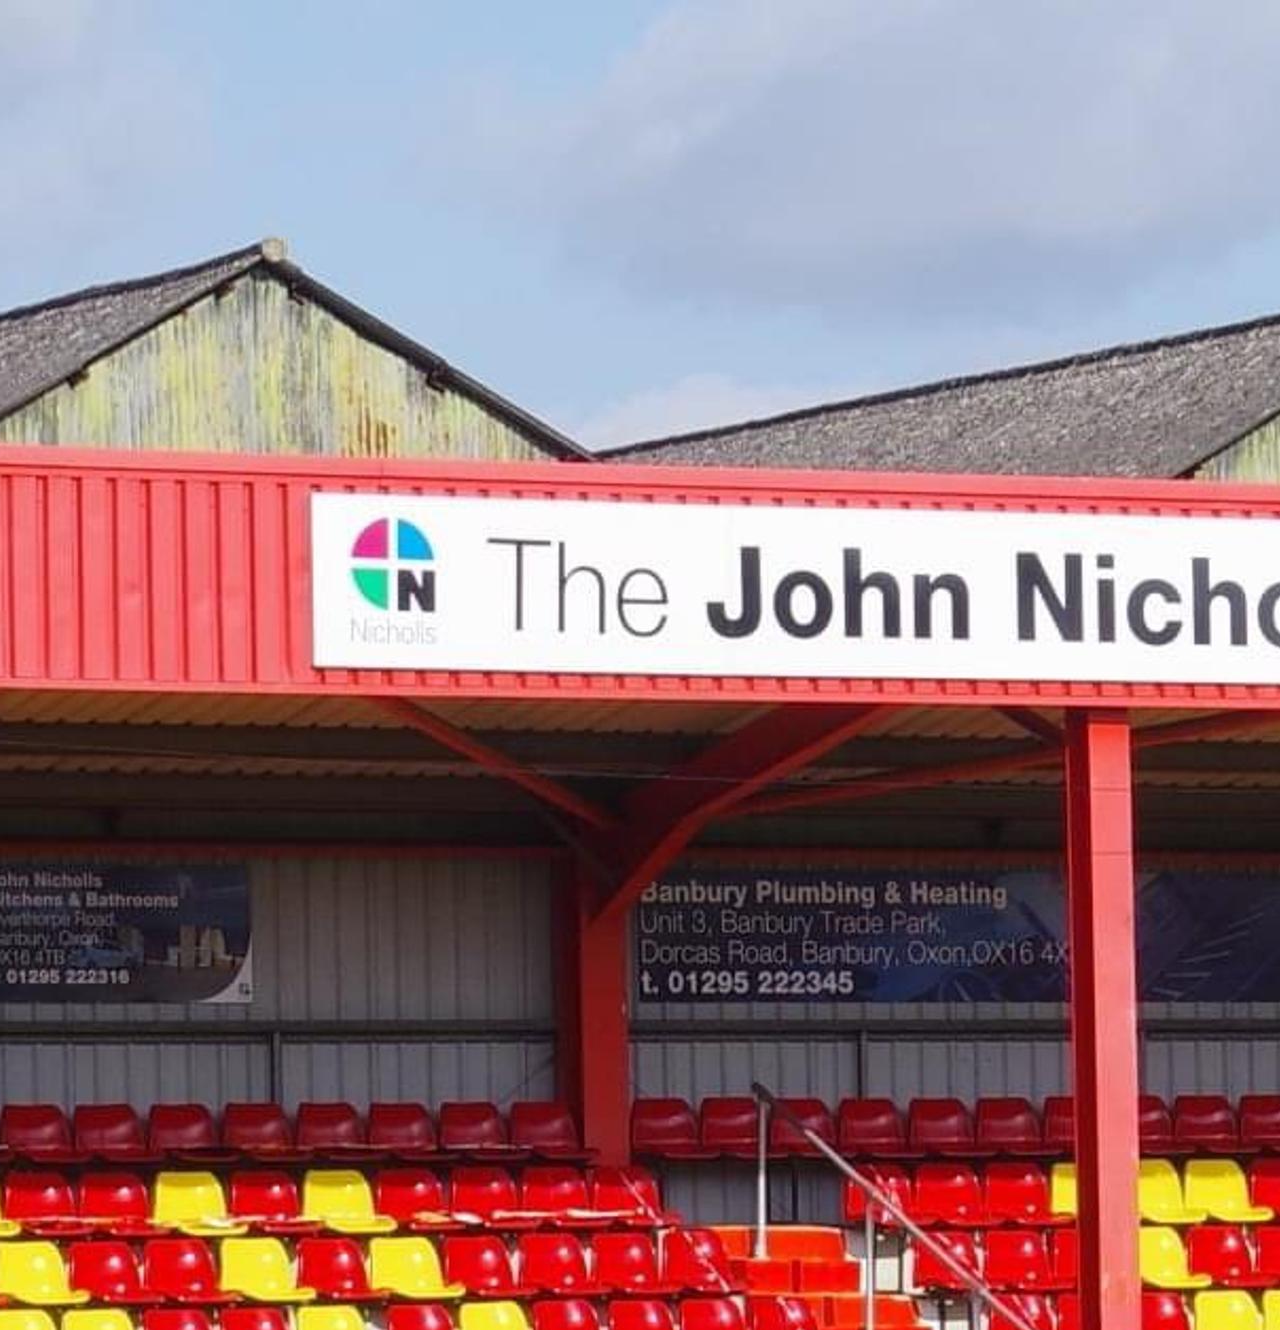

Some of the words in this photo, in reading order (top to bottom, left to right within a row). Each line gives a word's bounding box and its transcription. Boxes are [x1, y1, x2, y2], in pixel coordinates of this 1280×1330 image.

[486, 538, 668, 637] The
[707, 546, 969, 639] John
[350, 616, 437, 645] Nicholls
[34, 872, 102, 888] Nicholls
[756, 880, 875, 908] Plumbing
[884, 881, 902, 904] &
[910, 881, 1007, 908] Heating
[69, 892, 81, 907] &
[86, 891, 178, 907] Bathrooms
[640, 909, 684, 933] Unit
[721, 910, 814, 938] Banbury
[821, 910, 883, 935] Trade
[891, 910, 947, 939] Park,
[640, 939, 720, 964] Dorcas
[728, 940, 793, 967] Road,
[802, 940, 899, 970] Banbury,
[6, 970, 60, 985] 01295
[641, 970, 659, 994] t.
[668, 970, 749, 994] 01295
[758, 970, 855, 995] 222345
